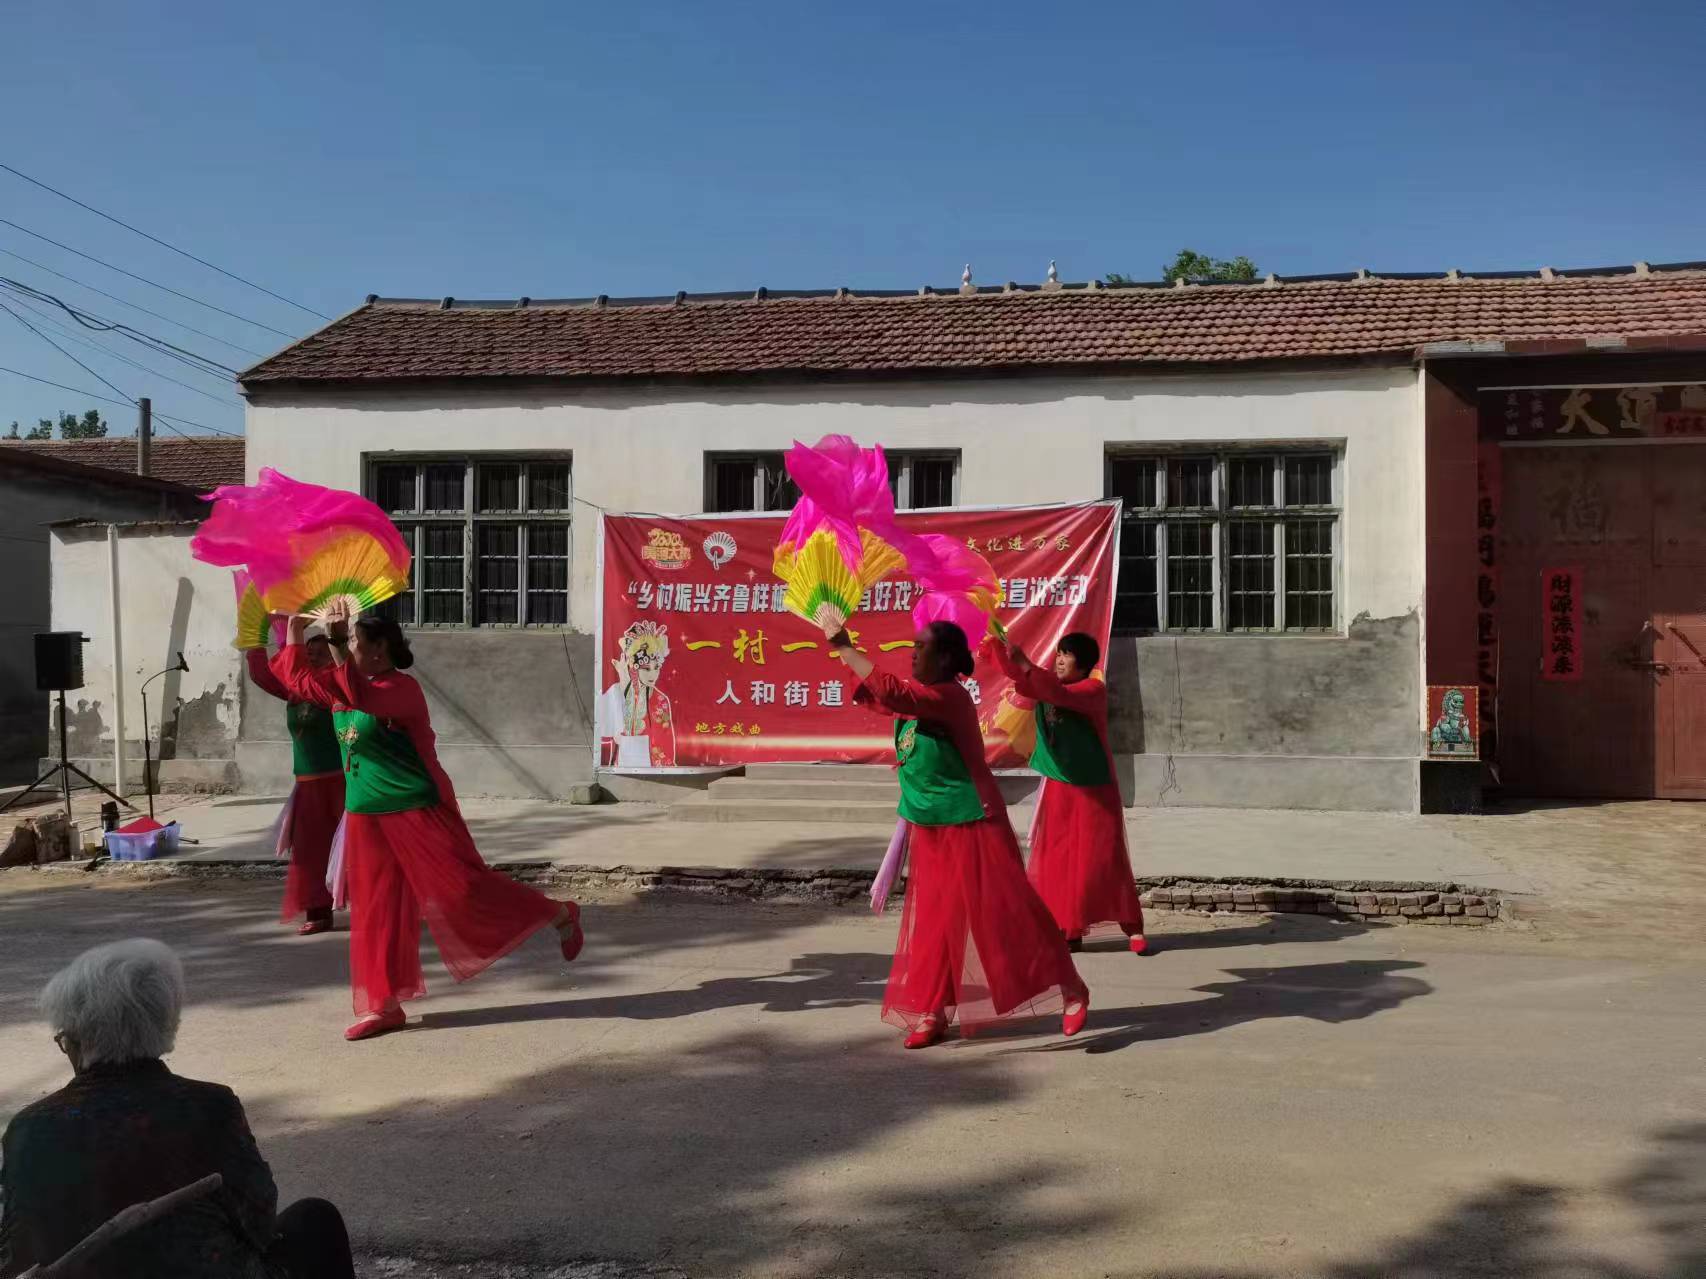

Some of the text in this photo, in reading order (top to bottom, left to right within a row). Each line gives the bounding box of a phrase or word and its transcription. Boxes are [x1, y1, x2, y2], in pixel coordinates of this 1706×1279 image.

[965, 536, 1071, 553] 文化进万家
[695, 722, 761, 736] 地方戏曲
